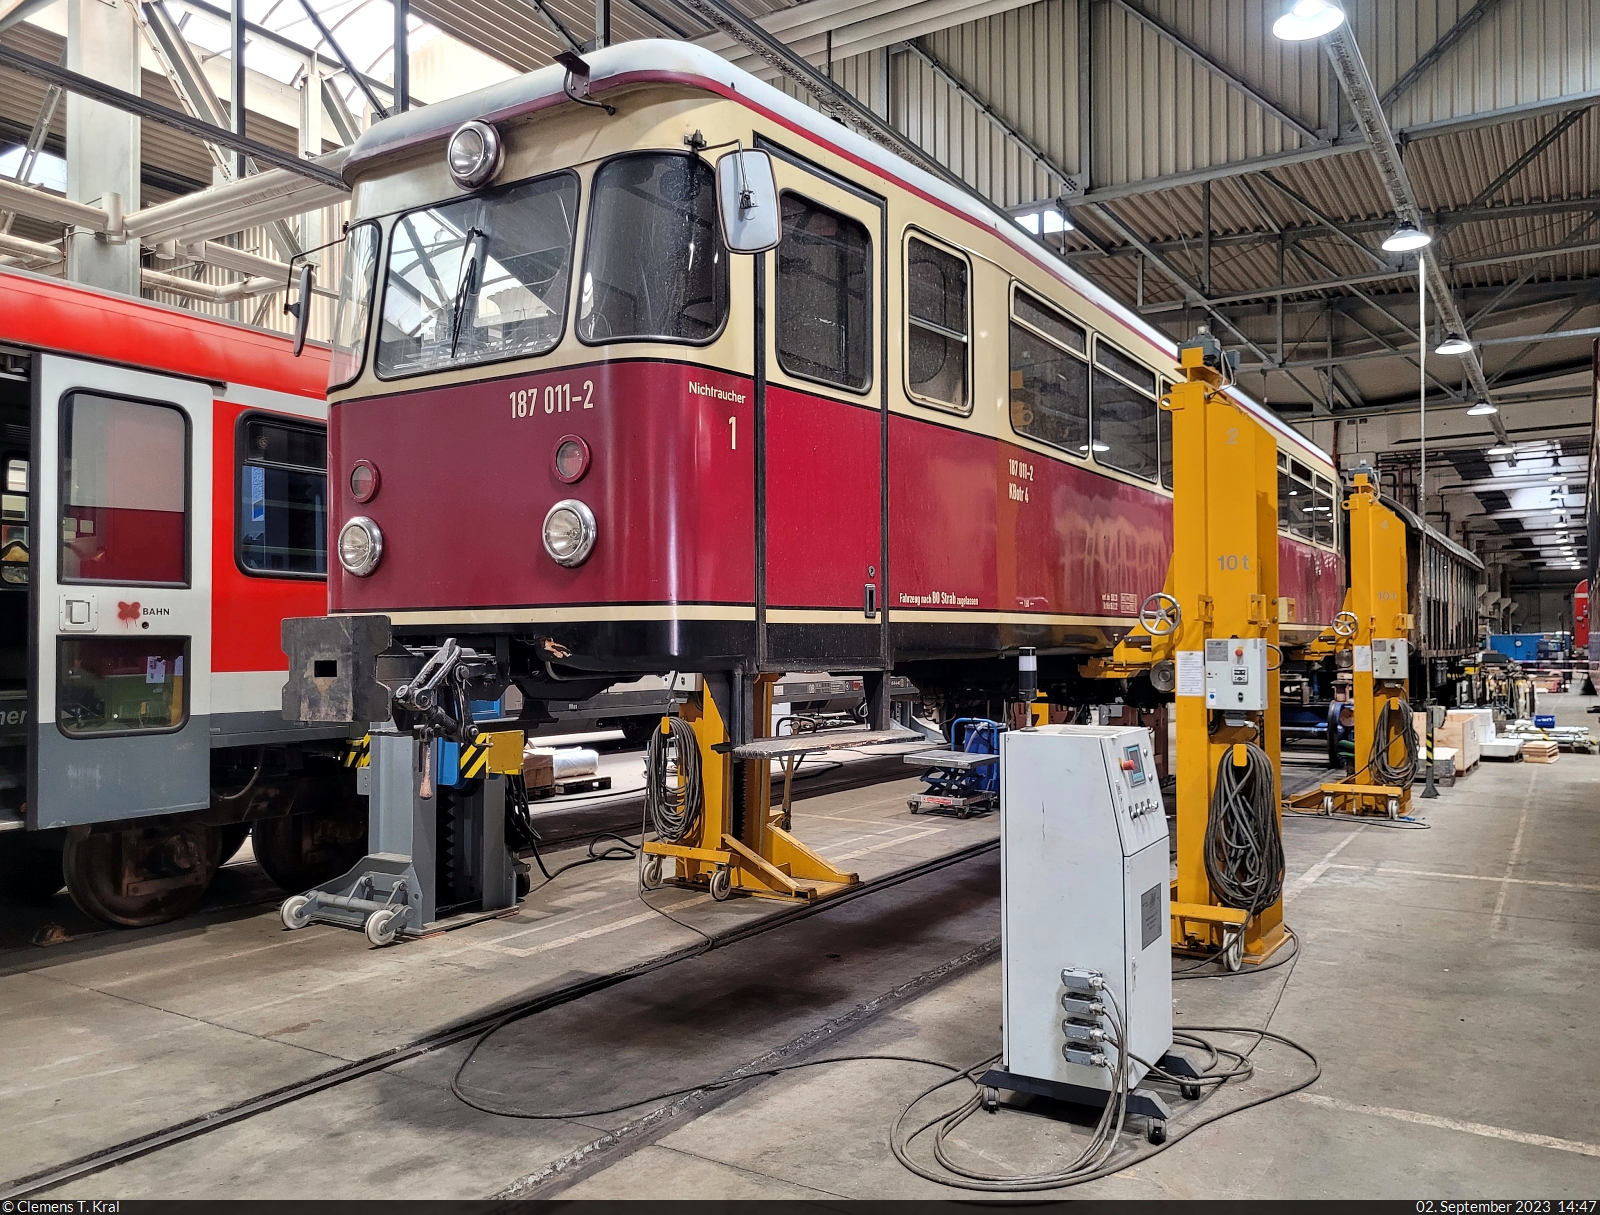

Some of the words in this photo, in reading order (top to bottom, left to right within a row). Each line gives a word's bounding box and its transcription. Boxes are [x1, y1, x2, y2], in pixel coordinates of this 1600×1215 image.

[509, 388, 538, 419] 187
[544, 380, 594, 414] 011-2
[689, 380, 746, 404] Nichtraucher
[728, 416, 737, 450] 1
[1226, 427, 1239, 445] 2
[1008, 458, 1019, 477] 187
[1019, 461, 1034, 481] 011-2
[1024, 486, 1029, 504] 4
[1217, 554, 1239, 571] 10
[1241, 554, 1250, 571] t
[899, 592, 921, 606] Fahrzeug
[921, 594, 932, 605] nach
[941, 592, 957, 606] Strab
[142, 607, 170, 616] BAHN
